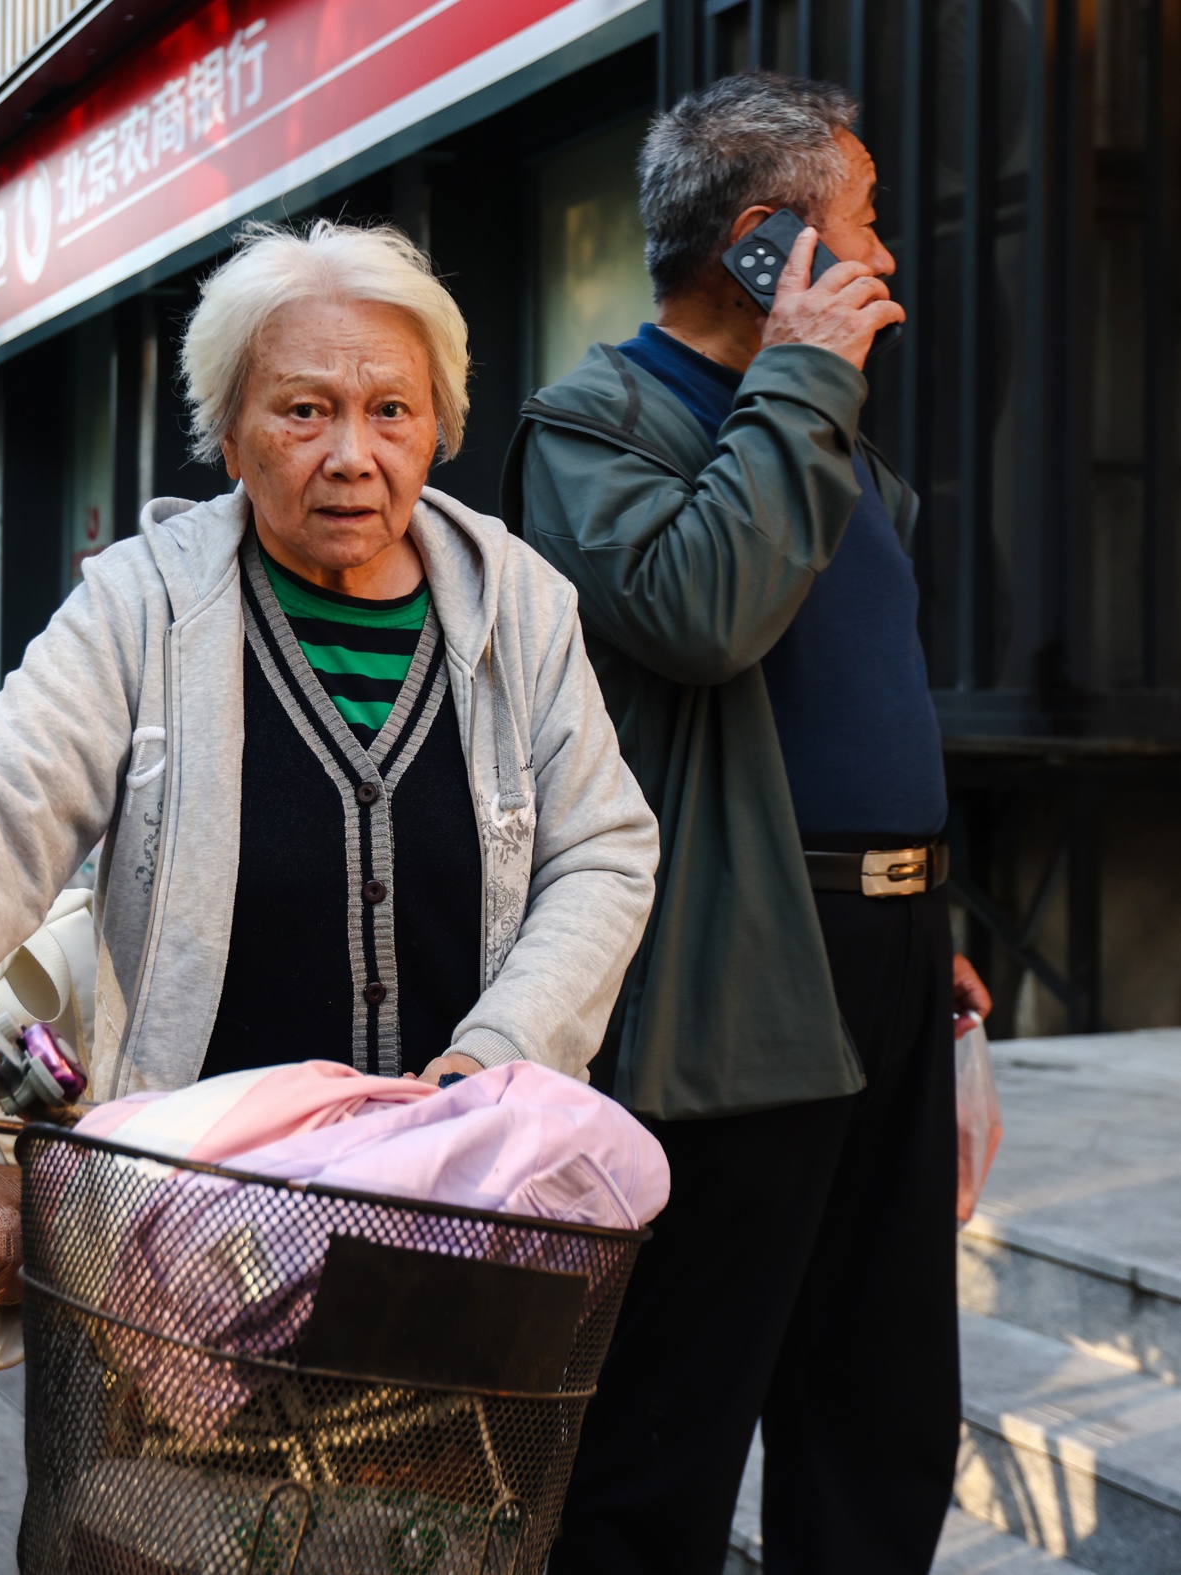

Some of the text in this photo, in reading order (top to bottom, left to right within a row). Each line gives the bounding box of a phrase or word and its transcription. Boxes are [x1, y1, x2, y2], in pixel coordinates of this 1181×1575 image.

[56, 18, 268, 226] 北京农商银行
